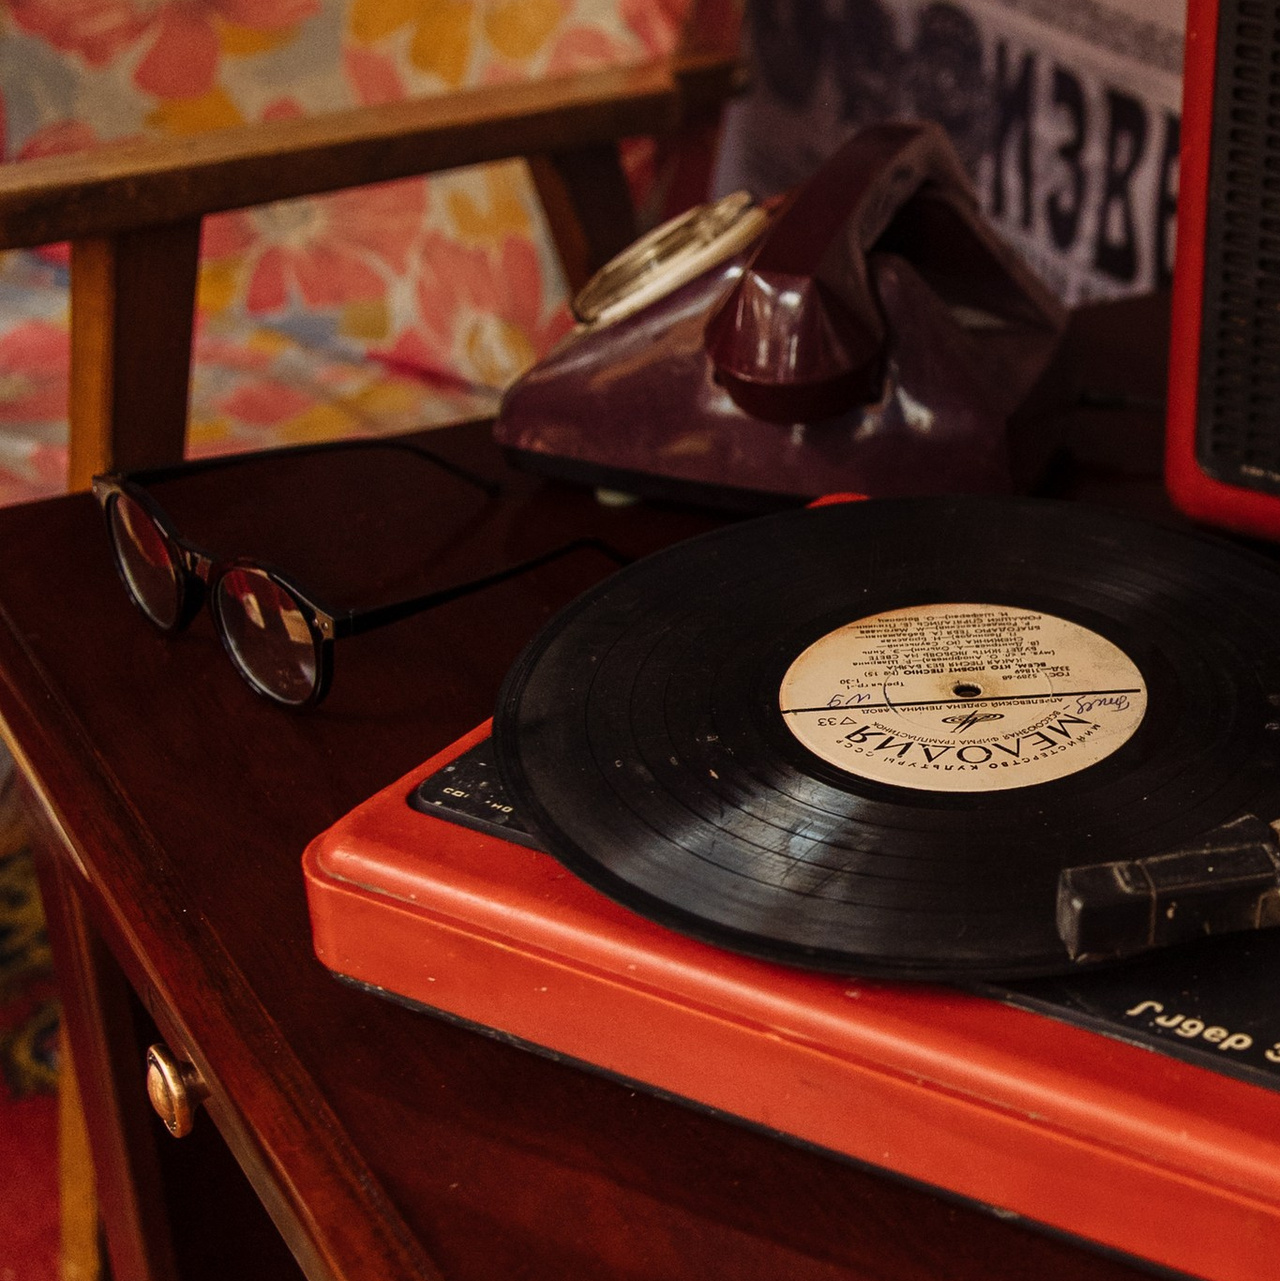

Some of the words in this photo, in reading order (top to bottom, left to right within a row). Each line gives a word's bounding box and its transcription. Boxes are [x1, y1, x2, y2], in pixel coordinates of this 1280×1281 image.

[1005, 645, 1037, 653] БУДЕТ
[986, 657, 1023, 665] КАКАЯ
[903, 668, 944, 676] ПЕСНЮ
[860, 707, 897, 715] АВОД
[898, 704, 943, 713] ЛЕНИНА
[946, 701, 988, 711] ОРДЕНА
[1001, 710, 1062, 741] ВСЕСОЮЗНАЯ
[870, 721, 956, 745] ГРАМПЛАСТИНОК
[844, 713, 1093, 765] МЕЛОДИЯ
[958, 736, 999, 745] ФИРМА
[835, 738, 875, 758] СССР
[988, 723, 1102, 770] МИНИСТЕРСТВО
[883, 755, 979, 772] КУЛЬТУРЫ
